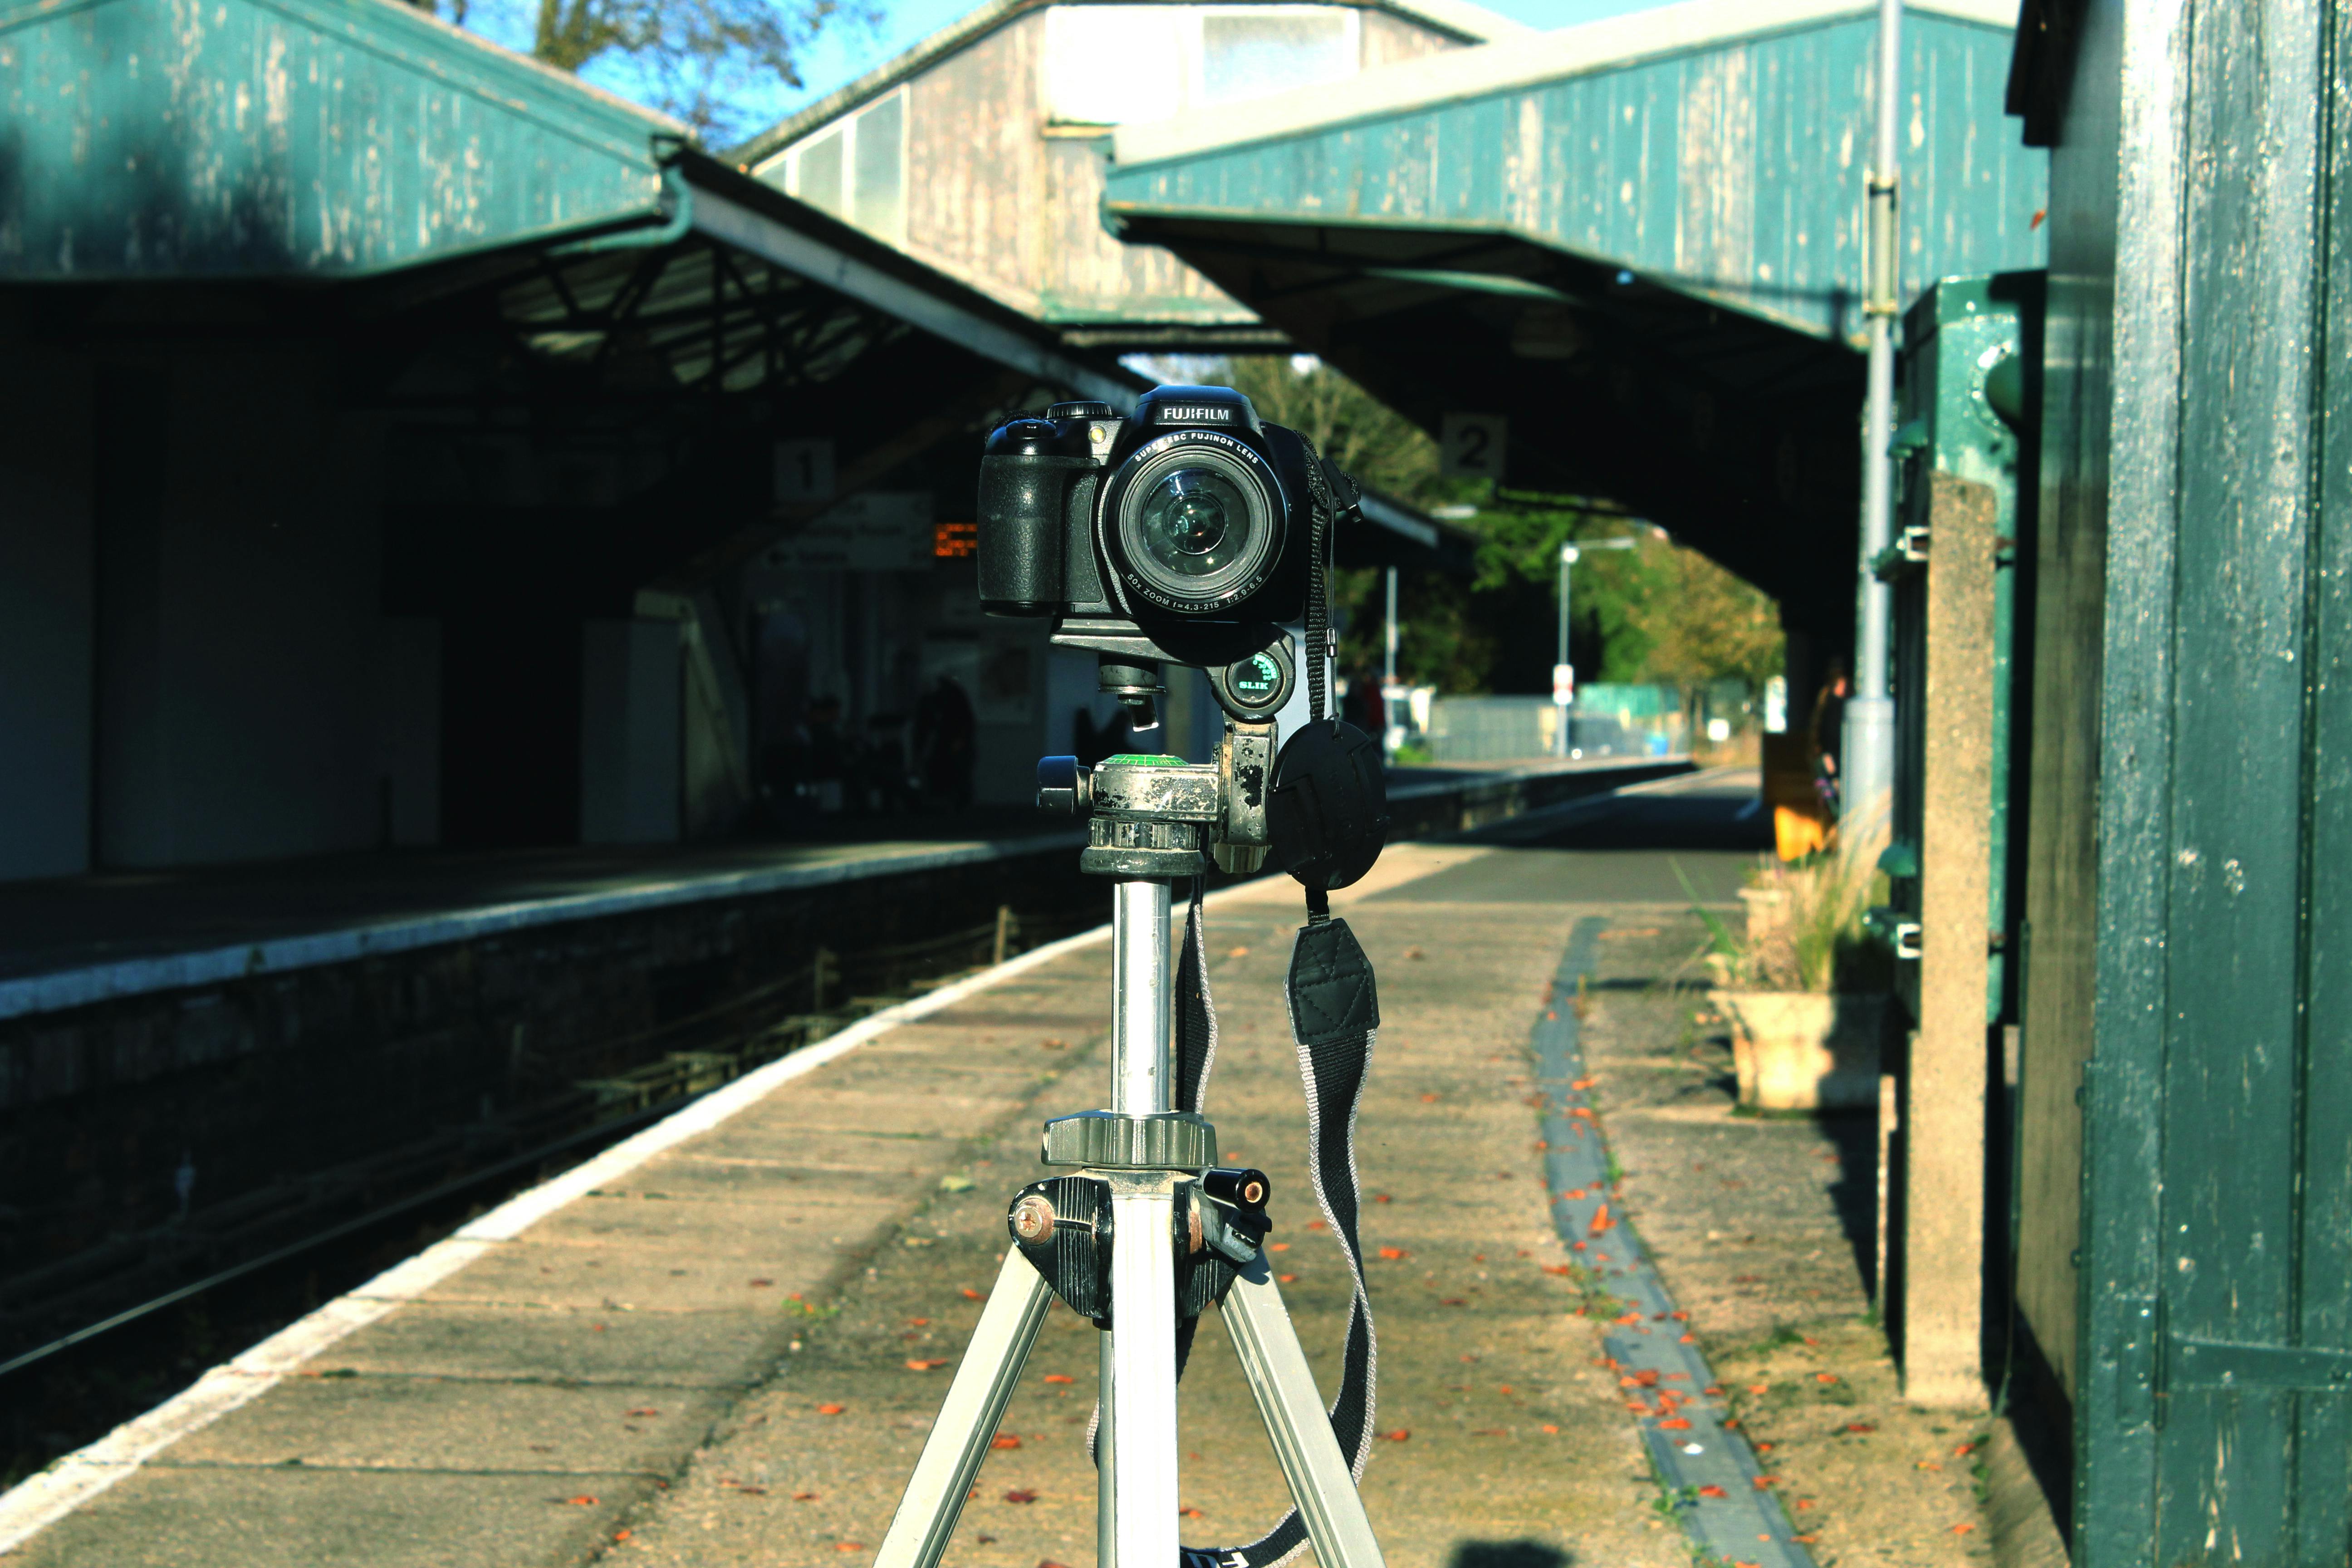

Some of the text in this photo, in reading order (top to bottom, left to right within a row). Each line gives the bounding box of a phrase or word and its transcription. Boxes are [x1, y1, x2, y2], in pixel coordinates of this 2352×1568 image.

[1164, 408, 1229, 420] FUJIFILM
[1167, 433, 1186, 443] EBC
[1191, 433, 1234, 447] FUJINON
[1236, 445, 1258, 464] LENS
[1459, 425, 1489, 469] 2
[797, 448, 812, 490] 1
[1127, 573, 1142, 589] 50x
[1143, 588, 1170, 606] ZOOM
[1239, 681, 1269, 690] SLIK
